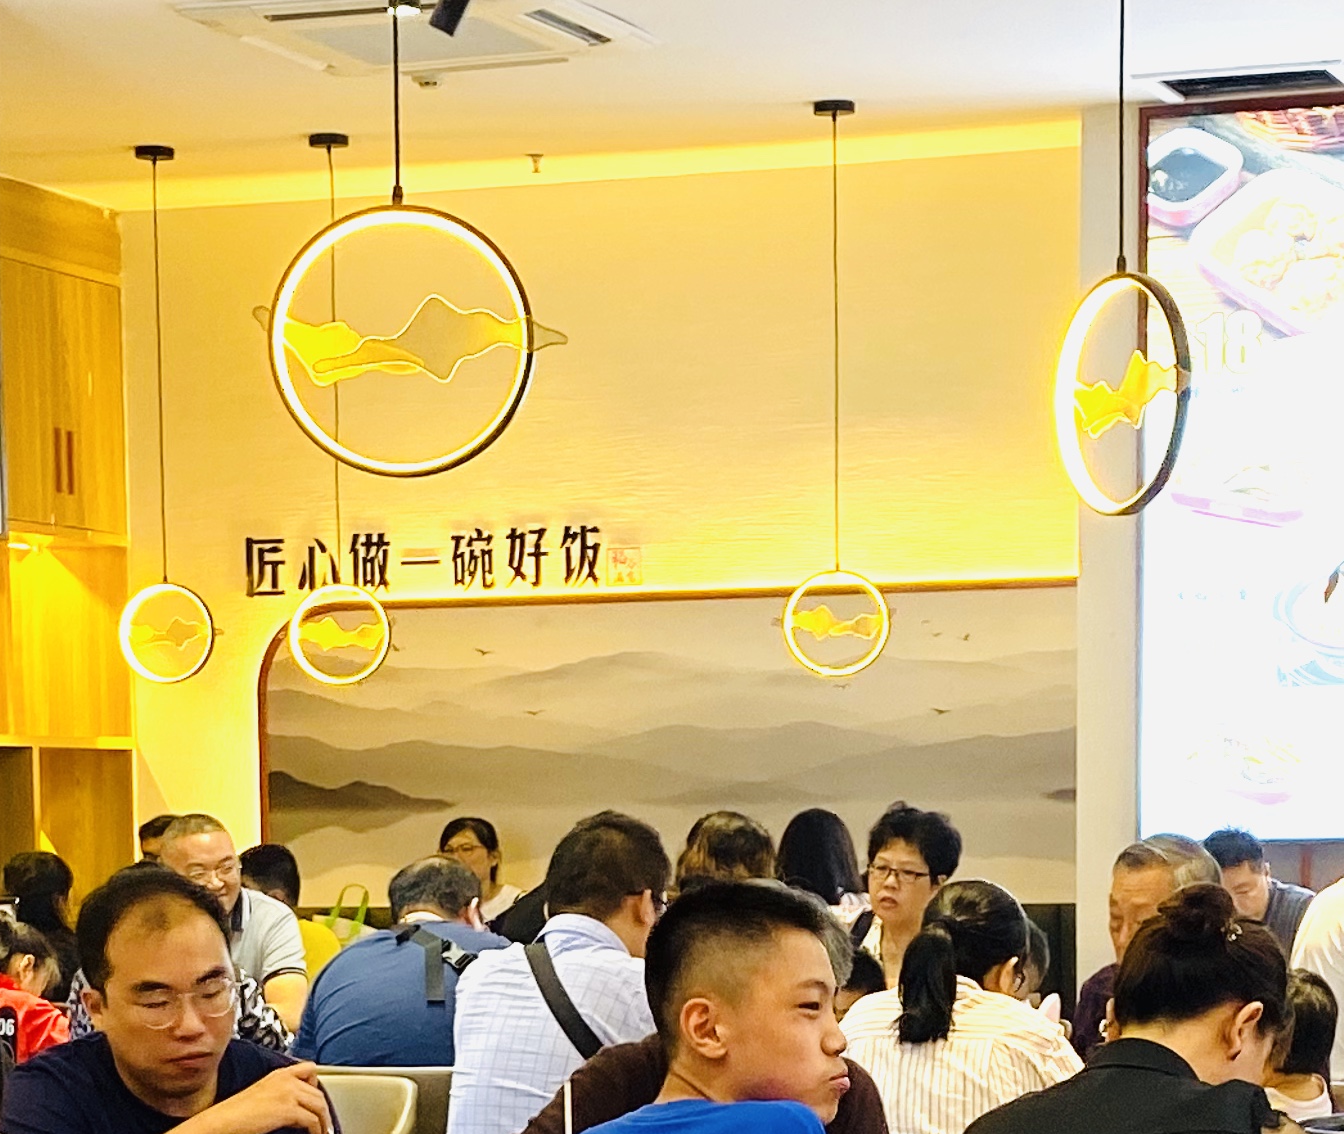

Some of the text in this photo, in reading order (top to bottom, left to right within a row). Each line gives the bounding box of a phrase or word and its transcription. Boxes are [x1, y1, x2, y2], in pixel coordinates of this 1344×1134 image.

[245, 525, 602, 598] 匠心做一碗好饭
